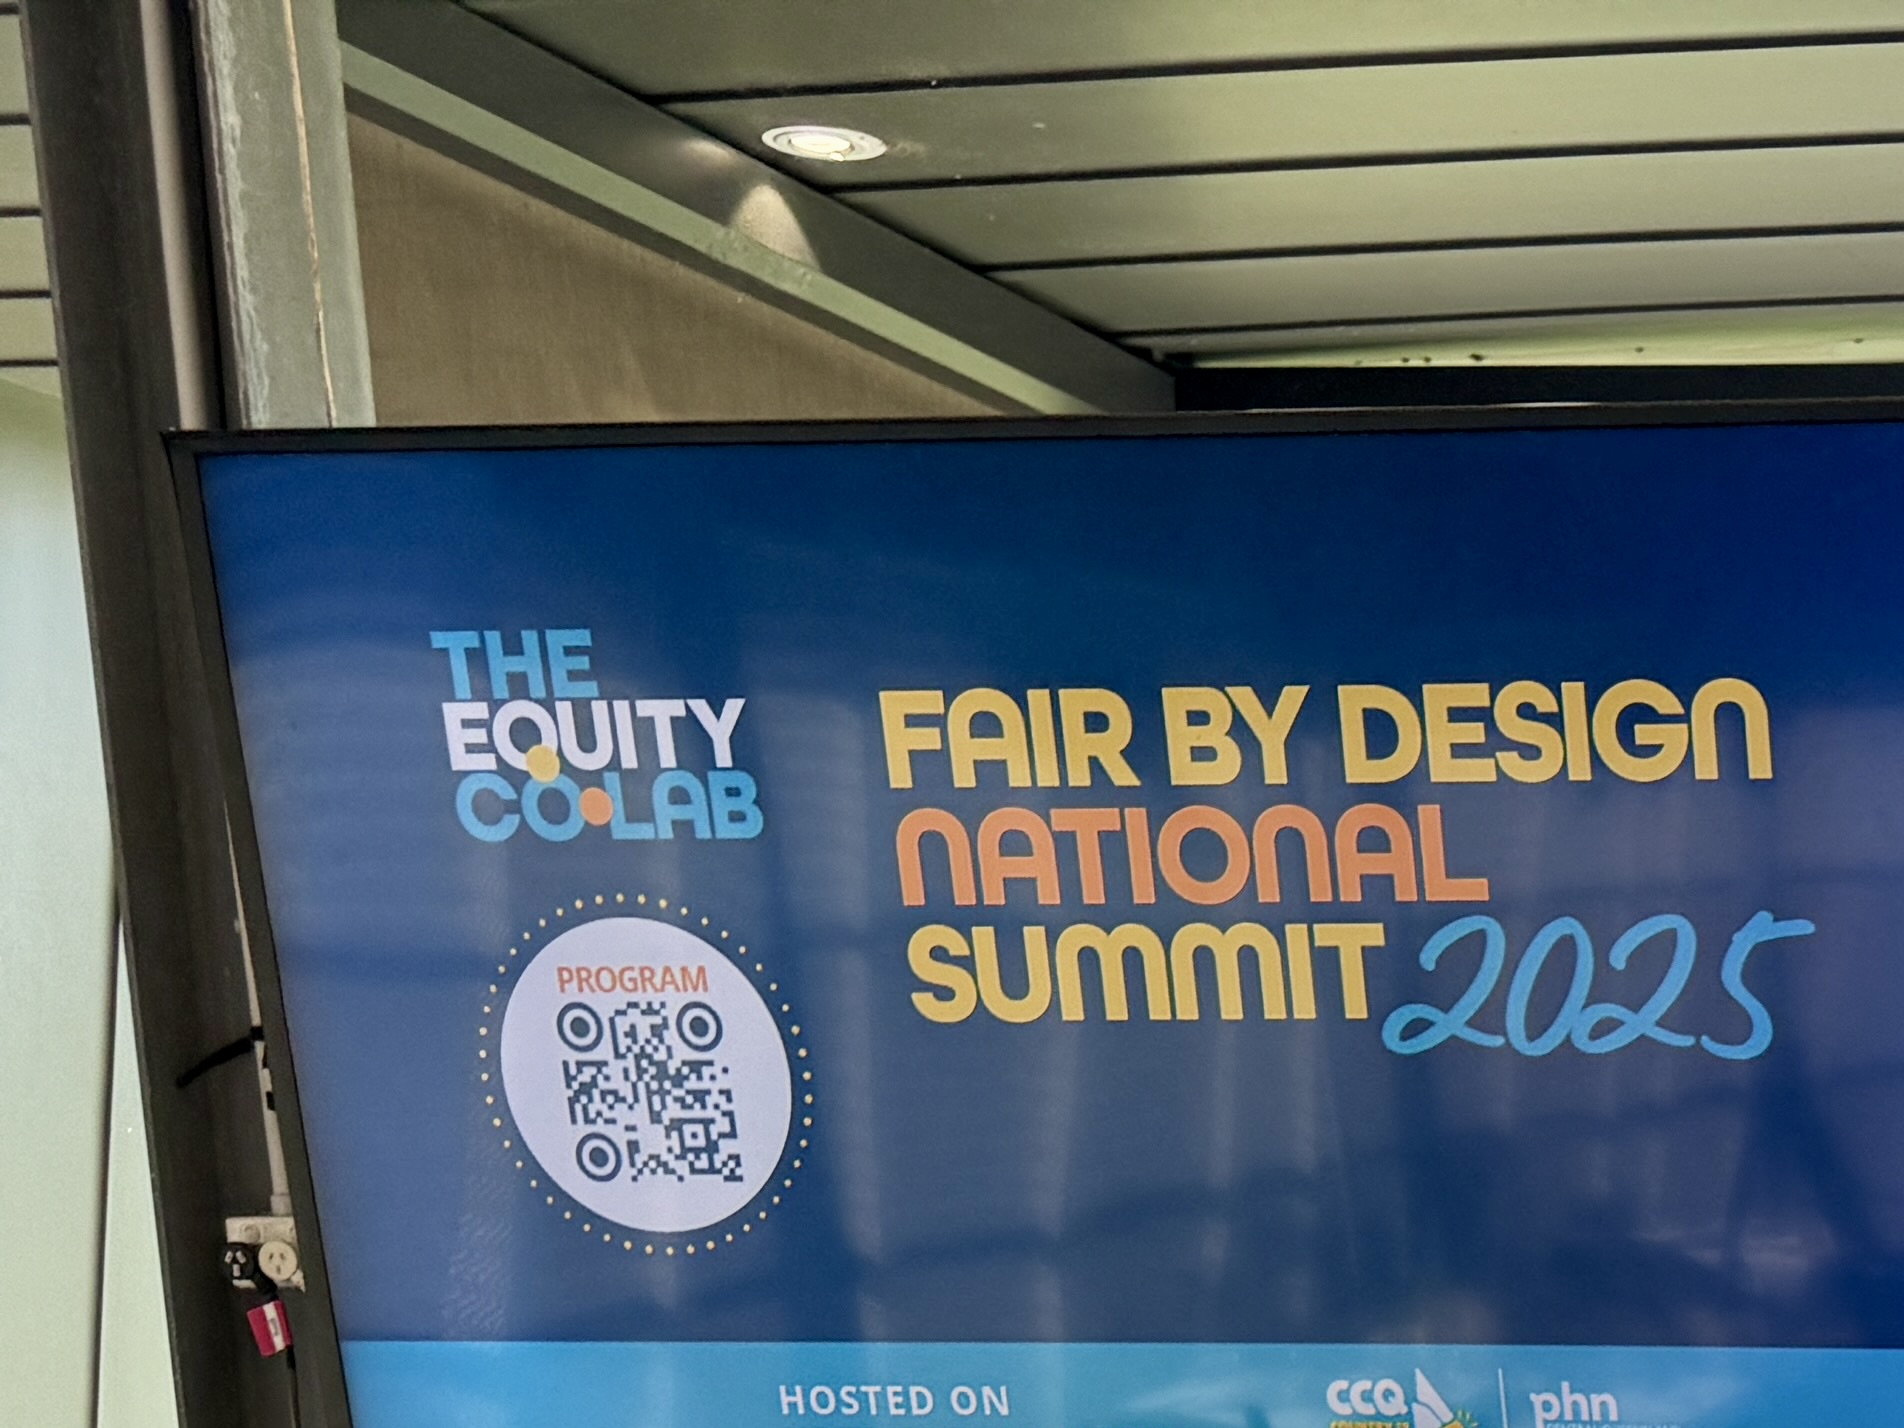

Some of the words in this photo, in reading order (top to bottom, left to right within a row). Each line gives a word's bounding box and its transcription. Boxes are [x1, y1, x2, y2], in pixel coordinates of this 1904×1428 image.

[429, 628, 599, 699] THE
[442, 697, 746, 774] EQUITY
[878, 686, 1142, 790] FAIR
[1160, 684, 1311, 786] BY
[1338, 676, 1774, 785] DESIGN
[896, 803, 1489, 907] NATIONAL
[556, 964, 709, 995] PROGRAM
[906, 922, 1386, 1024] SUMMIT
[1380, 908, 1816, 1061] 2025
[778, 1383, 934, 1417] HOSTED
[948, 1385, 1010, 1418] ON
[1327, 1378, 1408, 1417] CCQ
